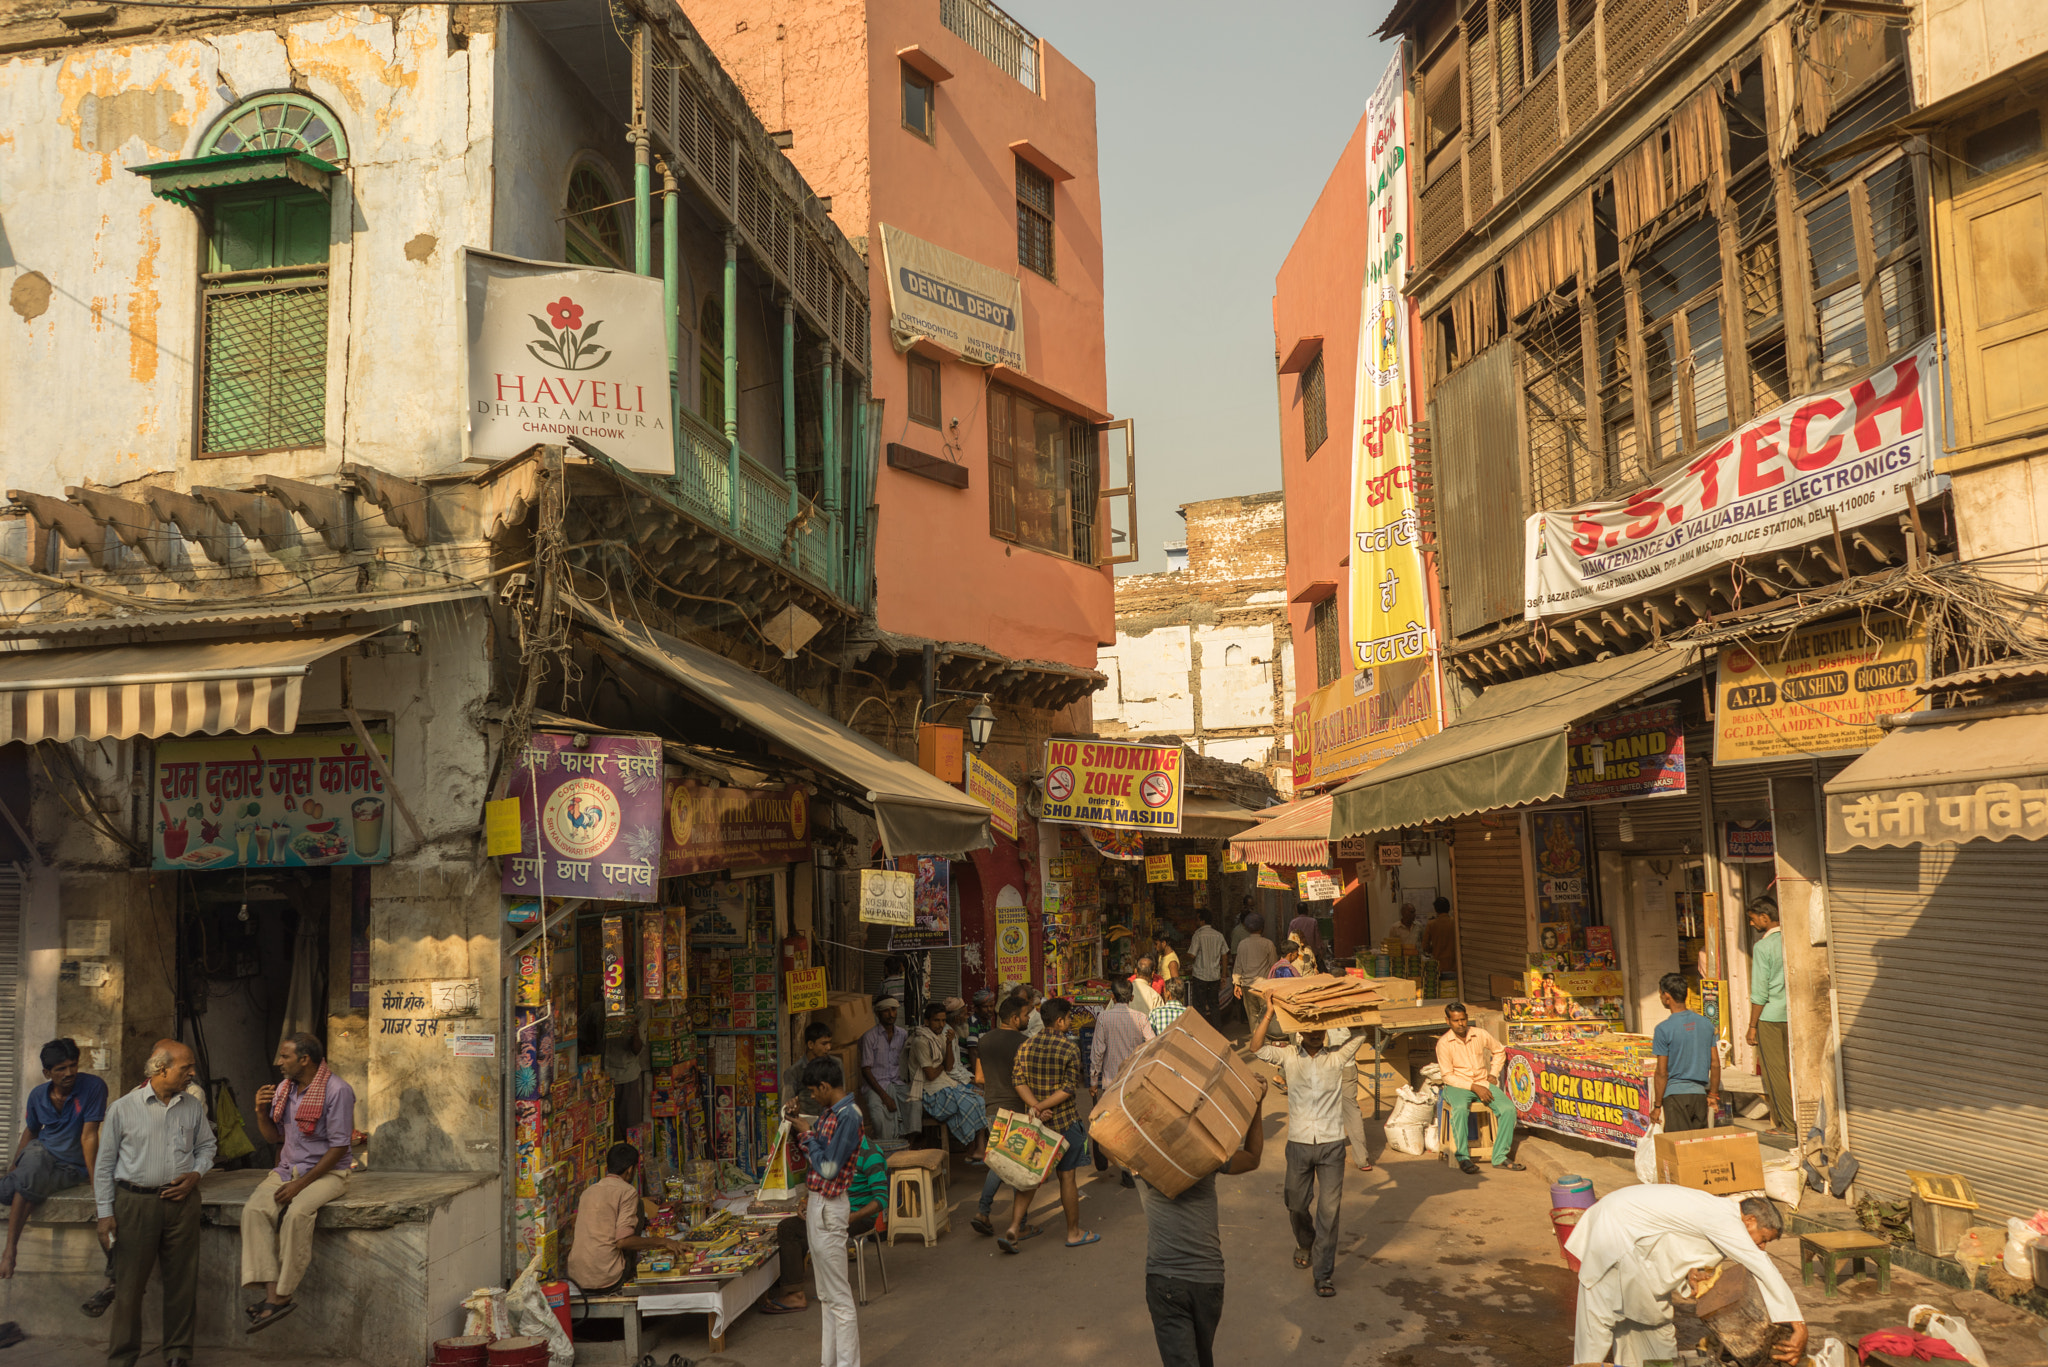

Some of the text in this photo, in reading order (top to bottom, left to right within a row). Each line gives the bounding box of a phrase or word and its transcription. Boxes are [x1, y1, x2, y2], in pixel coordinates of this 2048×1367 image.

[908, 273, 1009, 326] DENTAL DEPOT
[901, 312, 959, 340] ORTHODONTICS
[964, 345, 983, 358] MANI
[984, 351, 999, 364] GC
[967, 336, 1022, 361] INSTRUMENTS
[494, 373, 647, 413] HAVELI
[477, 400, 665, 430] DHARAMPURA
[522, 421, 625, 440] CHANDNI CHOWK
[1580, 445, 1912, 578] MAINTENANCE OF VALUABALE ELECTRONICS
[1547, 591, 1570, 604] BAZAR
[1595, 579, 1614, 592] NEAR
[1614, 573, 1637, 588] DARIBA
[1677, 551, 1694, 566] JAMA
[1695, 537, 1724, 558] MASJID
[1725, 527, 1760, 545] POLICE
[1762, 513, 1806, 537] STATION,
[1808, 490, 1876, 523] DELHI-110006
[1379, 568, 1400, 613] ही
[1356, 620, 1427, 665] पटाखे
[1813, 628, 1854, 657] DENTAL
[1784, 650, 1883, 676] Auth. Distributor
[1732, 662, 1916, 708] A.P.I. SUN SHINE BIOROCK
[1732, 713, 1754, 725] DEALS
[1769, 707, 1786, 720] 3M,
[1819, 697, 1860, 714] DENTAL
[1864, 690, 1910, 709] AVENUE,
[1293, 710, 1310, 758] SB
[1329, 708, 1347, 749] SITA
[1346, 699, 1368, 744] RAM
[1724, 726, 1744, 740] GC,
[1779, 716, 1832, 734] AMDENT
[1834, 713, 1846, 726] &
[1801, 733, 1817, 741] Near
[1817, 731, 1840, 739] Dariba
[560, 751, 609, 775] फायर
[1050, 742, 1179, 771] NO SMOKING
[160, 743, 317, 816] राम दुलारे जूस
[1295, 761, 1310, 779] Stores
[556, 781, 611, 802] COCK BRAND
[1083, 771, 1135, 797] ZONE
[1616, 782, 1643, 793] LIMITED,
[755, 799, 792, 823] WORKS
[1088, 797, 1110, 806] Order
[546, 817, 555, 832] SRI
[1043, 803, 1175, 825] SHO JAMA MASJID
[550, 828, 584, 856] KALISWARI
[584, 821, 617, 856] FIREWORKS
[1340, 840, 1353, 850] NO
[1149, 855, 1167, 865] RUBY
[1188, 855, 1204, 863] RUBY
[1382, 848, 1392, 857] NO
[556, 859, 592, 884] छाप
[601, 857, 655, 887] पटाखे
[1554, 881, 1569, 892] NO
[864, 907, 909, 920] NO PARKING
[646, 962, 659, 979] 2
[1000, 955, 1028, 965] COCK BRAND
[1001, 965, 1027, 973] FANCY FIRE
[605, 964, 623, 988] 3
[791, 970, 819, 984] RUBY
[792, 982, 822, 993] SPARKLERS
[1006, 973, 1023, 981] WORKS
[1568, 978, 1594, 986] GOLDEN
[792, 1000, 806, 1009] ZONE
[801, 990, 822, 999] SMOKING
[380, 1018, 439, 1037] गाजर जूस
[1539, 1070, 1640, 1111] COCK BRAND
[1553, 1096, 1578, 1117] FIRE
